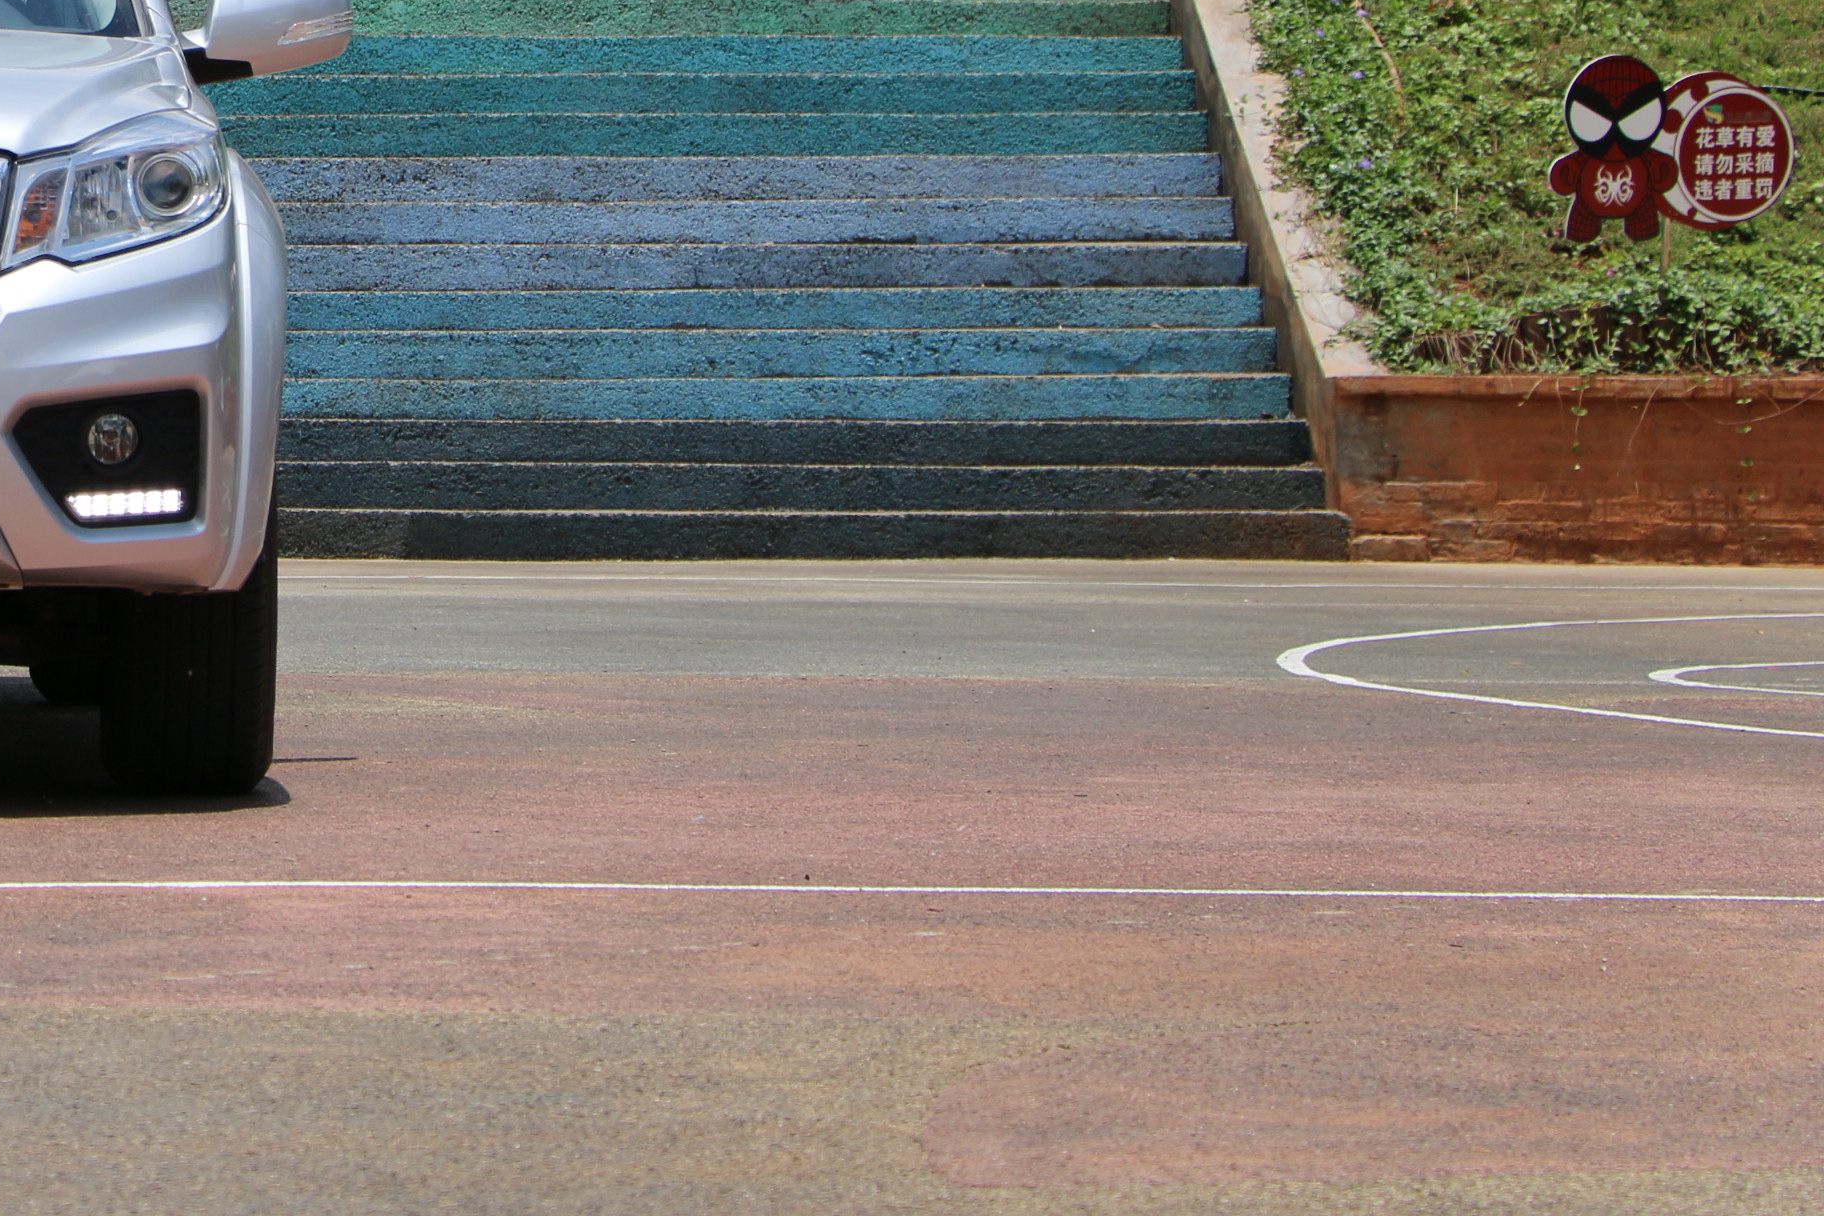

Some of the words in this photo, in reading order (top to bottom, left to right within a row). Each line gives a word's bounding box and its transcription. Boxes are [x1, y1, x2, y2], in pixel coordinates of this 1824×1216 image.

[1695, 126, 1775, 149] 花草有爱
[1694, 153, 1775, 175] 请勿采摘
[1694, 178, 1773, 201] 违者重罚
